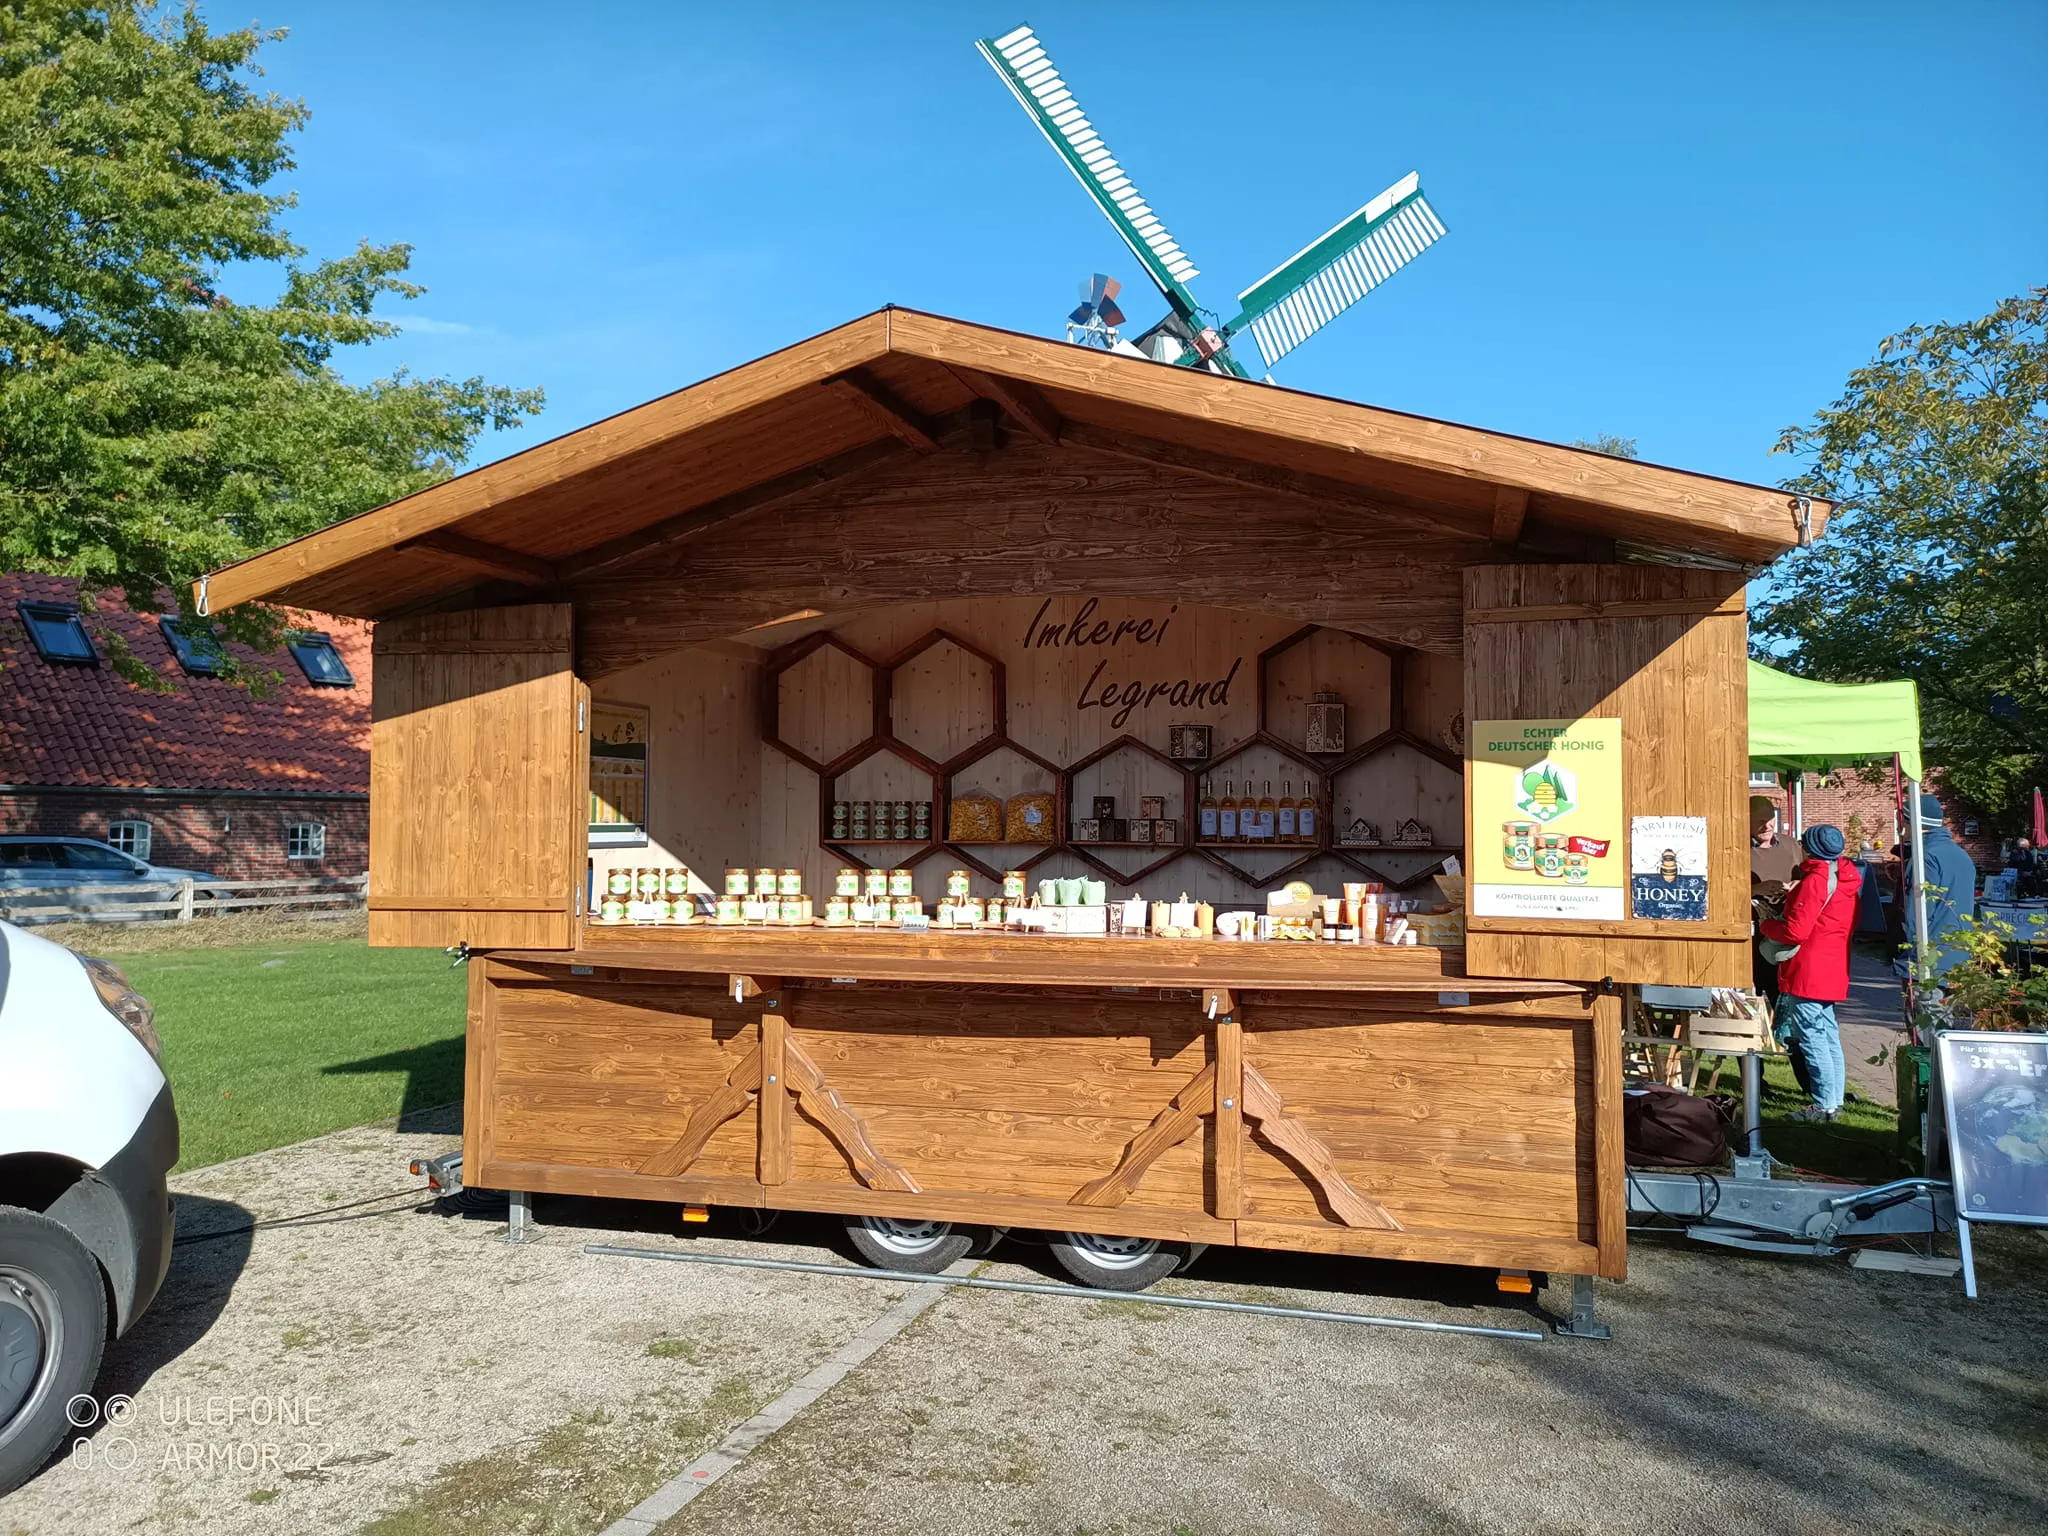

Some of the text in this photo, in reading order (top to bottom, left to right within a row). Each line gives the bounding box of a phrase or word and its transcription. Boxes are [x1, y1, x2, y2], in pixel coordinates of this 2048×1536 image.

[1023, 597, 1178, 648] Imkerei
[1077, 657, 1242, 729] Legrand
[1523, 728, 1567, 738] ECHTER
[1488, 741, 1604, 751] DEUTSCHER HONIG
[1495, 893, 1557, 902] KONTROLLIERTE
[1637, 887, 1703, 902] HONEY
[1970, 1055, 1996, 1069] 3x
